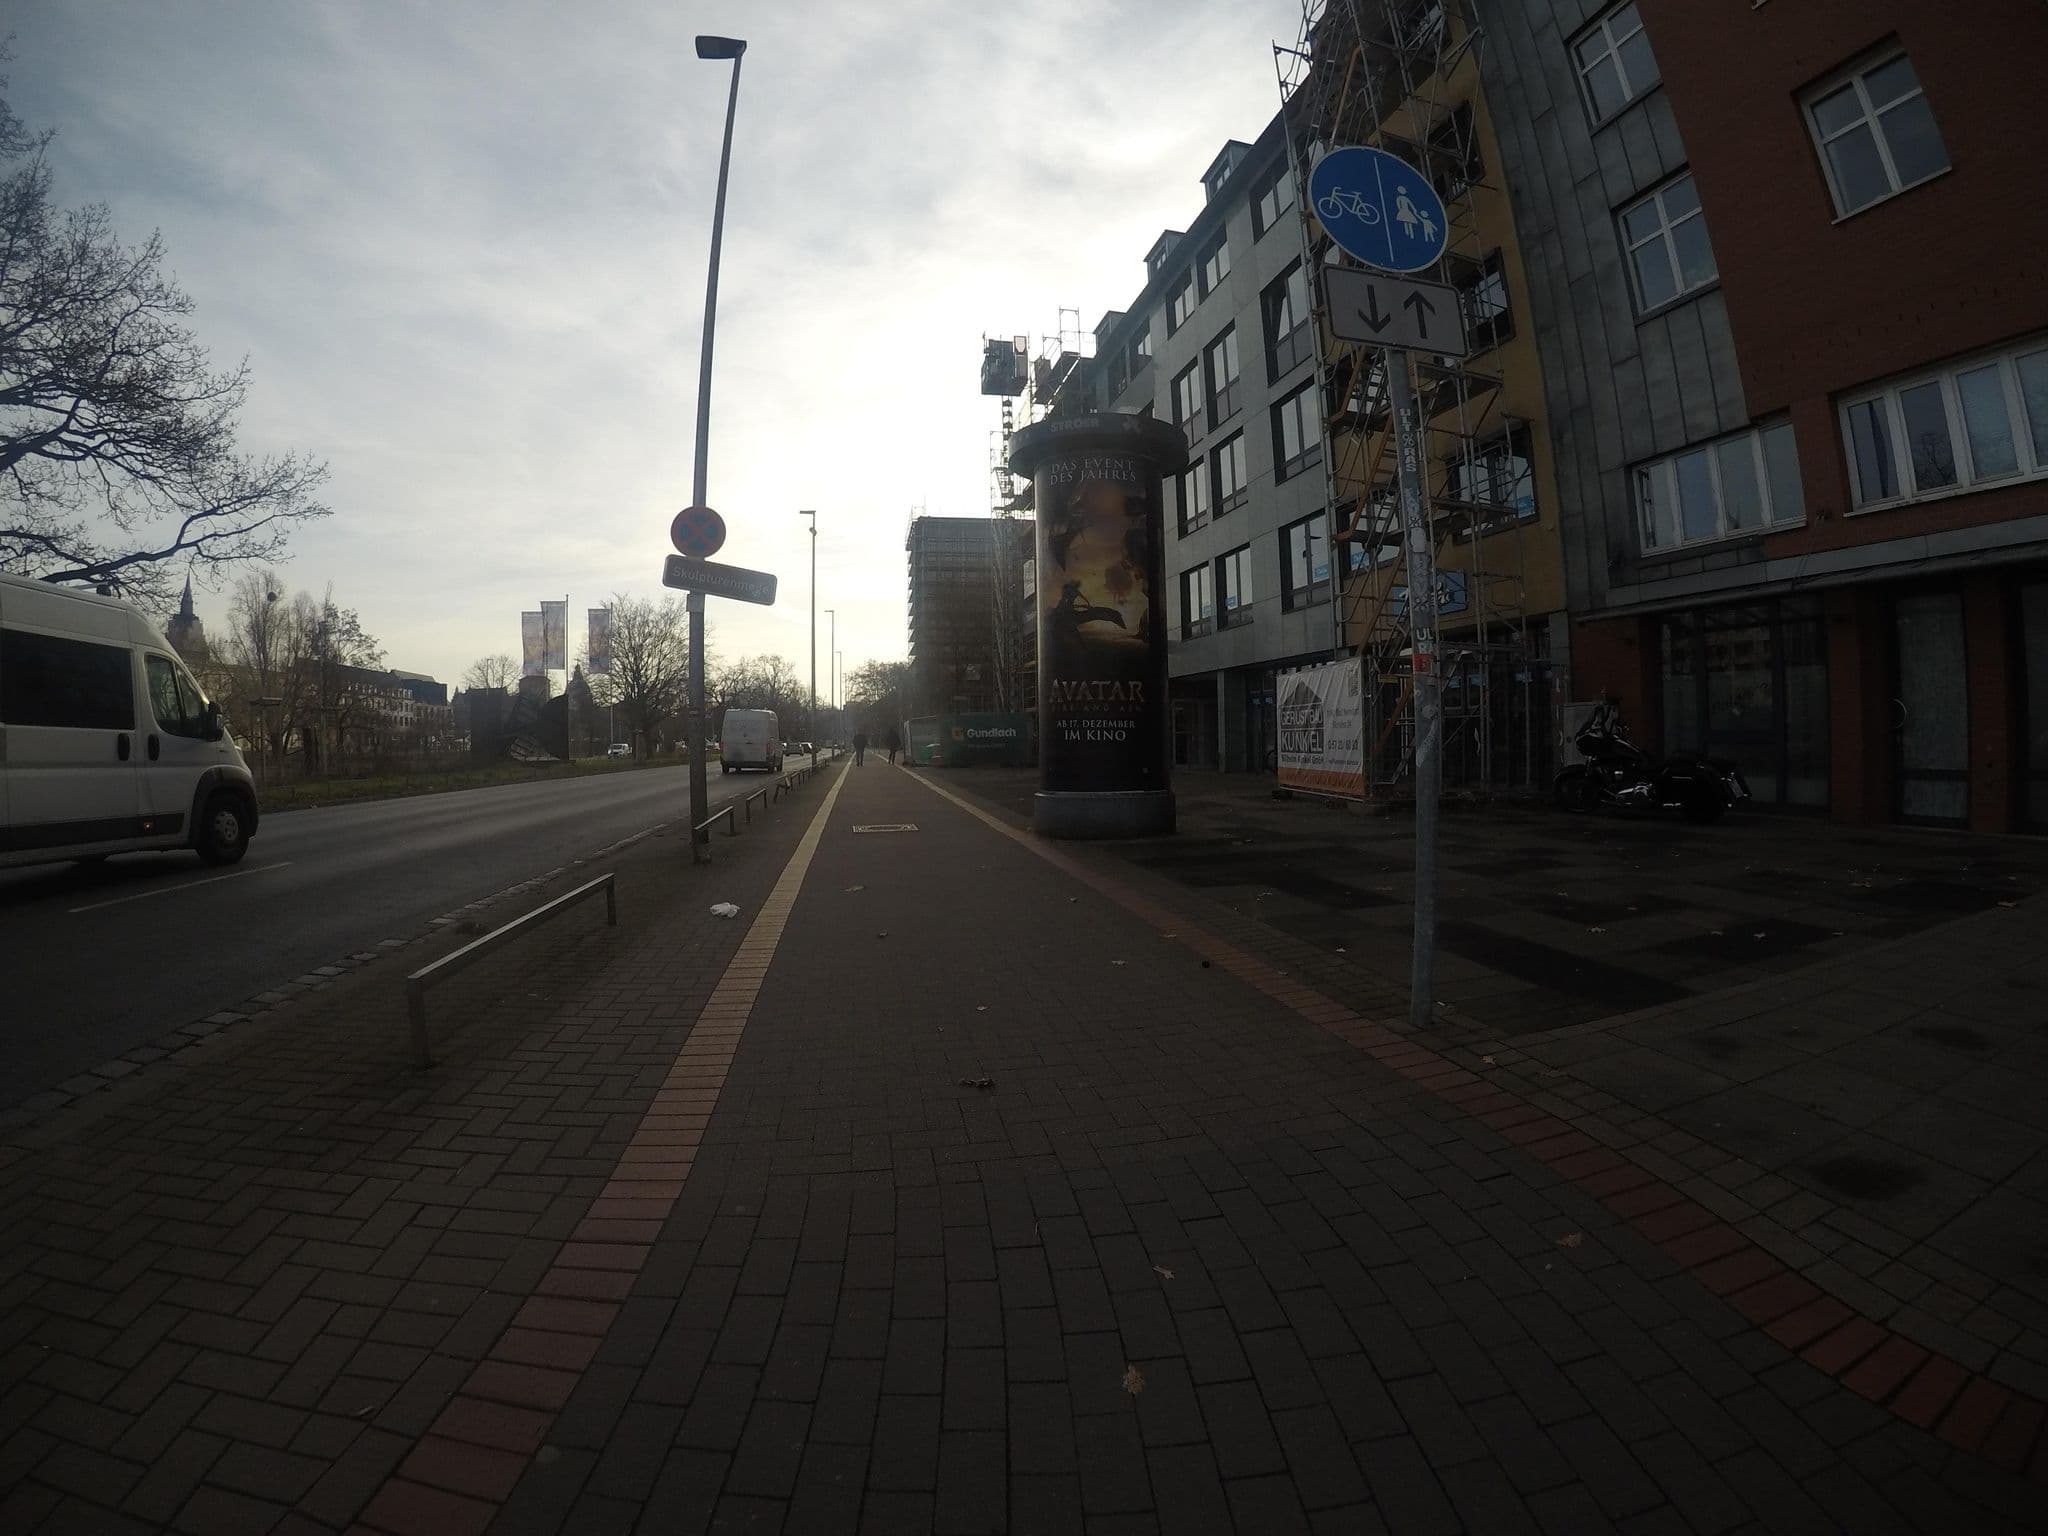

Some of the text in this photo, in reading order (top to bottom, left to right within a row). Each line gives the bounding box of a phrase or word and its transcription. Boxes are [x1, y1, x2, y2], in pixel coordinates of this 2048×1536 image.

[1052, 458, 1134, 474] DAS EVENT
[1050, 470, 1136, 485] DES JAHRES
[1049, 677, 1144, 702] AVATAR
[1056, 719, 1067, 728] AB
[1082, 719, 1136, 728] DEZEMBER
[966, 727, 1017, 738] Gundlach
[1065, 730, 1127, 741] IM KINO
[1281, 730, 1323, 751] KUNKEL
